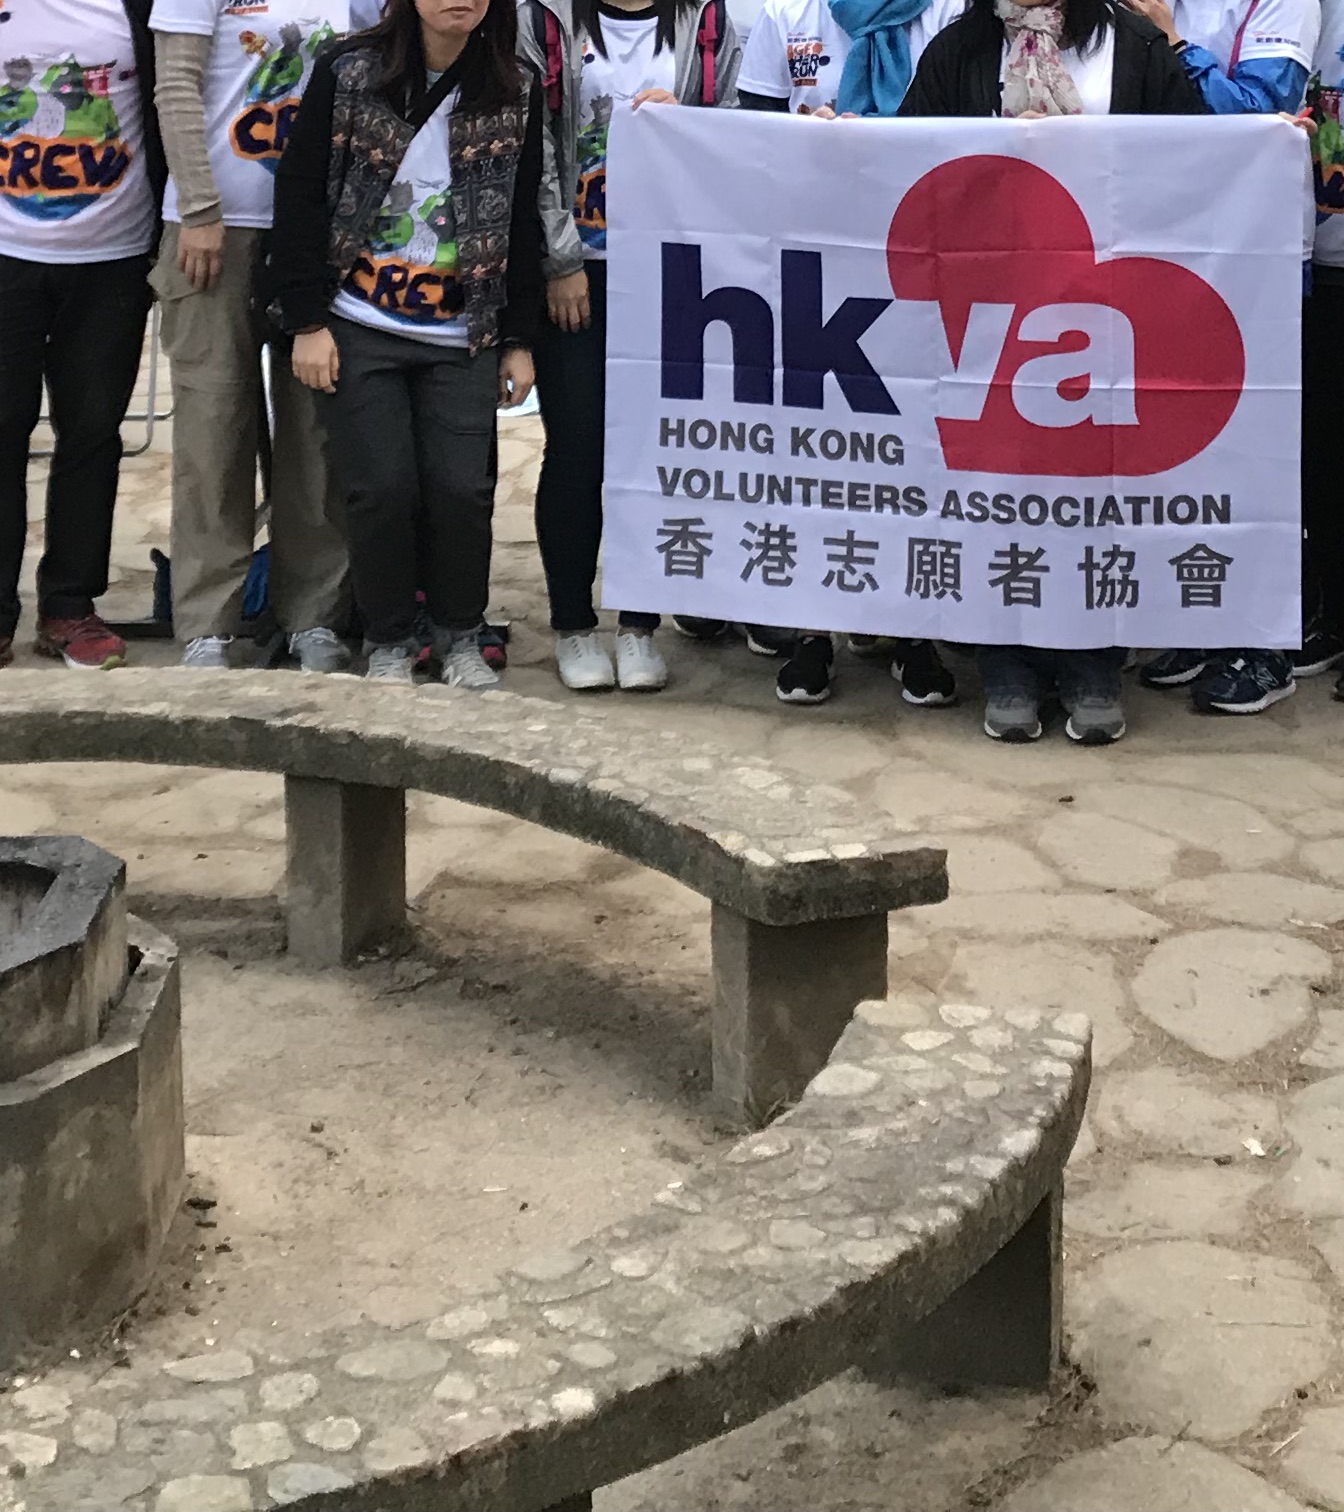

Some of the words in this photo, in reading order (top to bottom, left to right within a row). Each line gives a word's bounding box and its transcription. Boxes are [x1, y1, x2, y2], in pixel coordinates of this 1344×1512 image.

[658, 417, 775, 455] HONG
[790, 427, 906, 466] KONG
[656, 466, 928, 518] VOLUNTEERS
[940, 488, 1233, 529] ASSOCIATION
[656, 517, 1235, 610] 香港志願者協會
